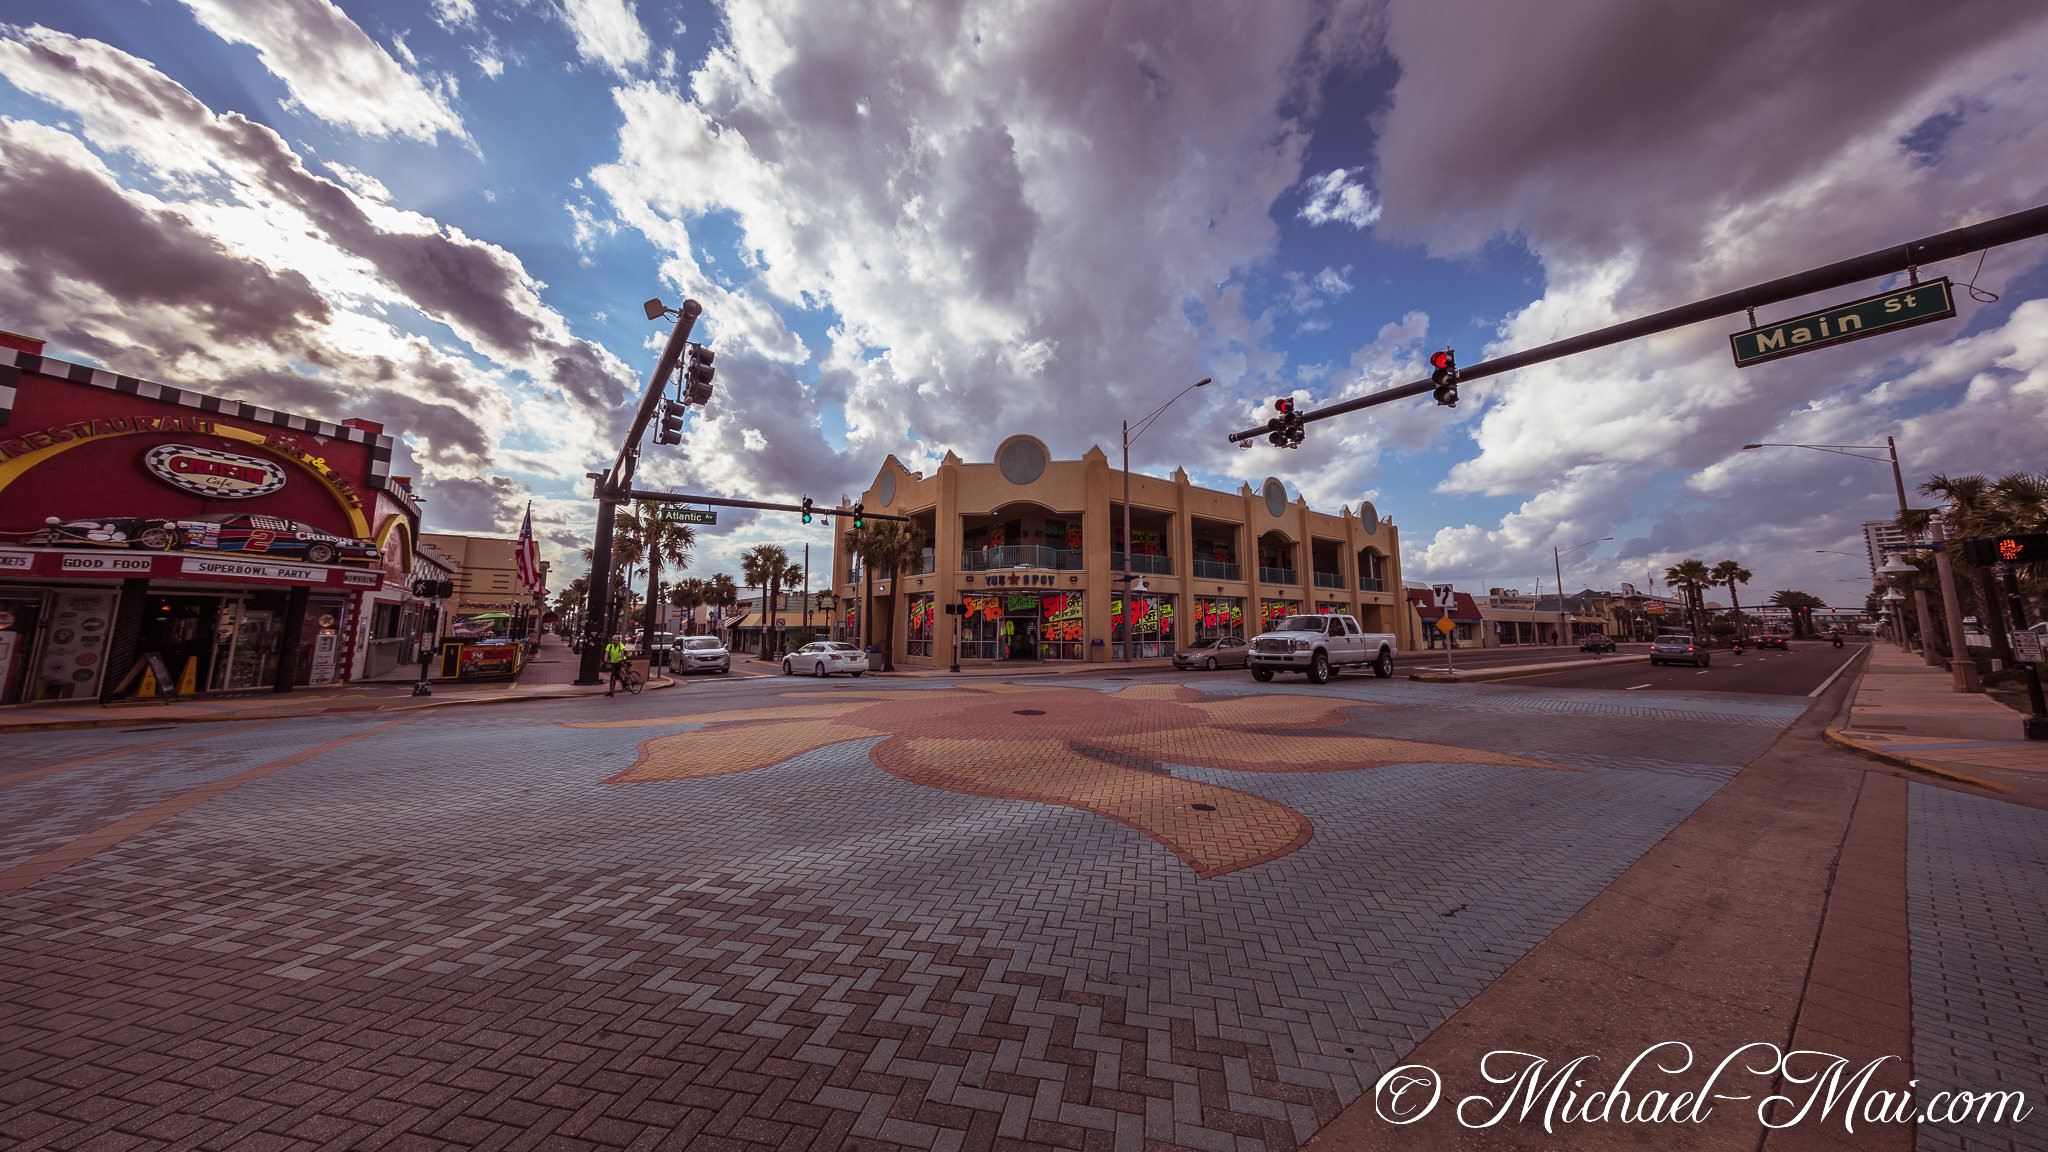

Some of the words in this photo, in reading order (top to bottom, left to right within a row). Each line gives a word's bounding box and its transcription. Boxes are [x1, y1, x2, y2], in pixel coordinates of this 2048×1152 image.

[1756, 314, 1863, 353] Main
[1884, 294, 1917, 312] St
[0, 416, 217, 459] RESTAURANT
[206, 476, 233, 487] Cafe
[665, 511, 702, 521] Atlantic
[243, 529, 277, 553] 2
[0, 556, 27, 566] KETS
[63, 558, 104, 568] GOOD
[113, 559, 151, 569] FOOD
[199, 562, 268, 576] SUPERBOWL
[278, 568, 311, 579] PARTY
